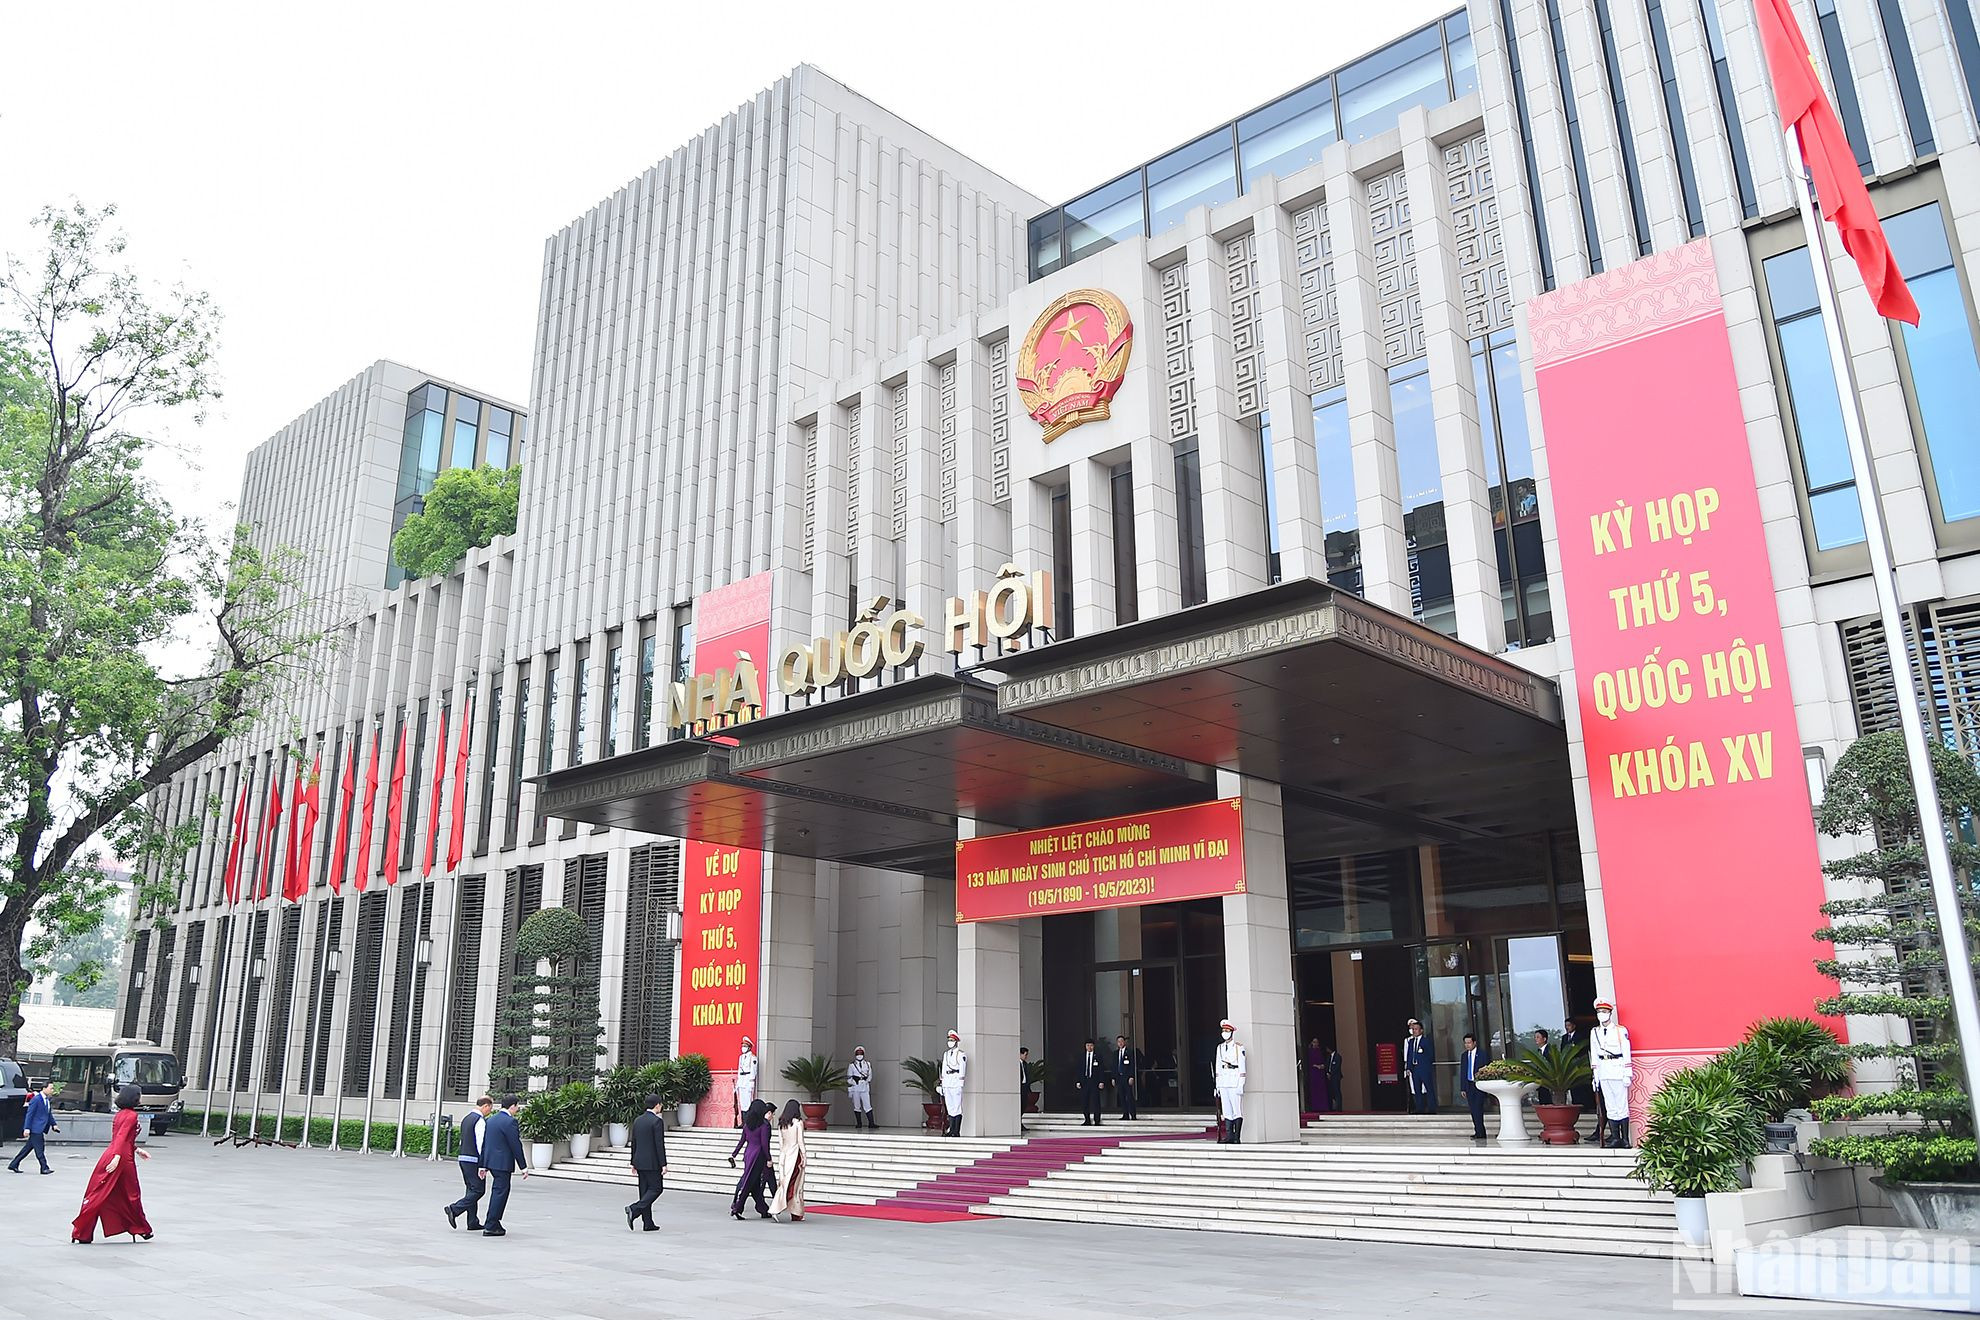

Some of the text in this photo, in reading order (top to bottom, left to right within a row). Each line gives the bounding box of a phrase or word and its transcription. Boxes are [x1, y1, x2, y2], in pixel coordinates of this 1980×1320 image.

[1590, 487, 1720, 555] KỲ HỌP
[1609, 568, 1728, 631] THỨ 5,
[668, 562, 1053, 729] NHÀ QUỐC HỘI
[1592, 637, 1772, 720] QUỐC HỘI
[1609, 730, 1773, 798] KHÓA XV
[1030, 823, 1150, 856] NHIỆT LIỆT CHÀO MỪNG
[705, 848, 740, 878] VỀ DỰ
[967, 839, 1229, 888] 133 NĂM NGÀY SINH CHỦ TỊCH HỒ CHÍ MINH VĨ ĐẠI
[700, 888, 742, 916] KỲ HỌP
[1028, 886, 1082, 908] (19/5/1890
[1093, 876, 1155, 899] 19/5/2023)!
[701, 925, 738, 951] THỨ 5,
[691, 958, 746, 991] QUỐC HỘI
[692, 1000, 743, 1026] KHÓA XV
